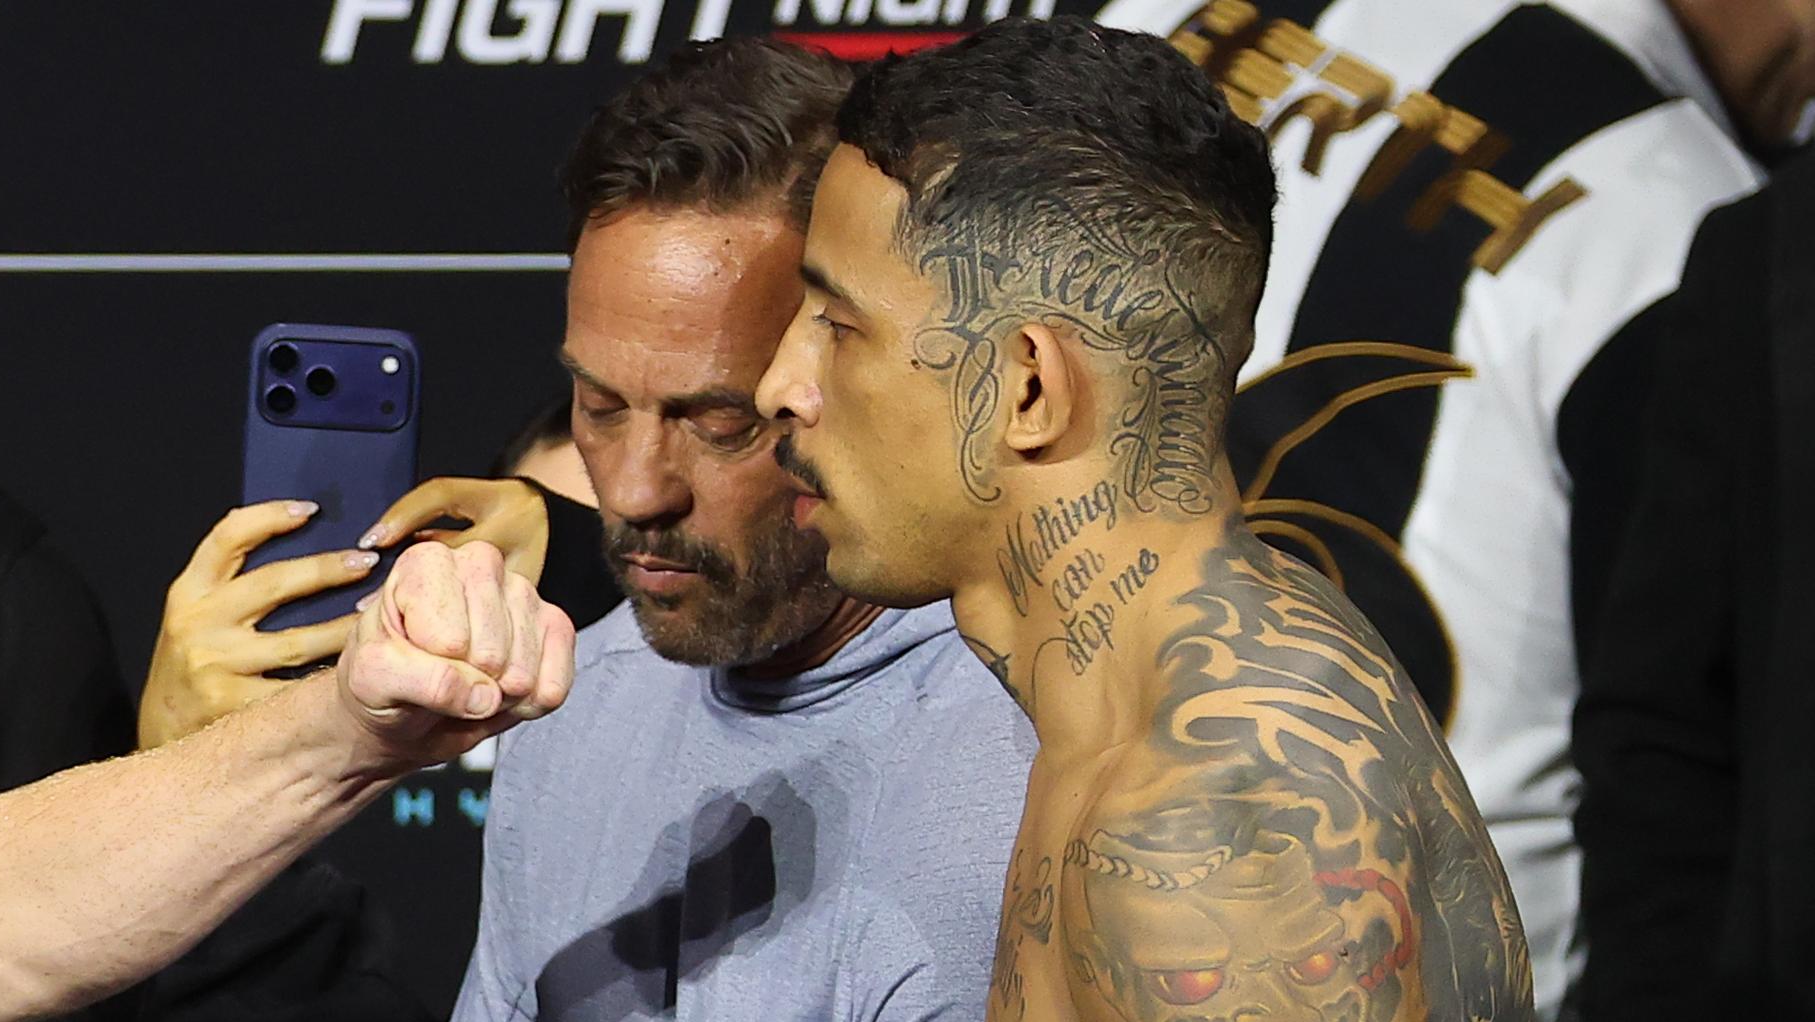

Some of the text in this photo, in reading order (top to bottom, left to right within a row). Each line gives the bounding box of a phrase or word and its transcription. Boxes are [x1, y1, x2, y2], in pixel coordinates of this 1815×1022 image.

[996, 480, 1118, 617] Nothing
[1051, 548, 1106, 612] can
[1056, 547, 1160, 676] stop me
